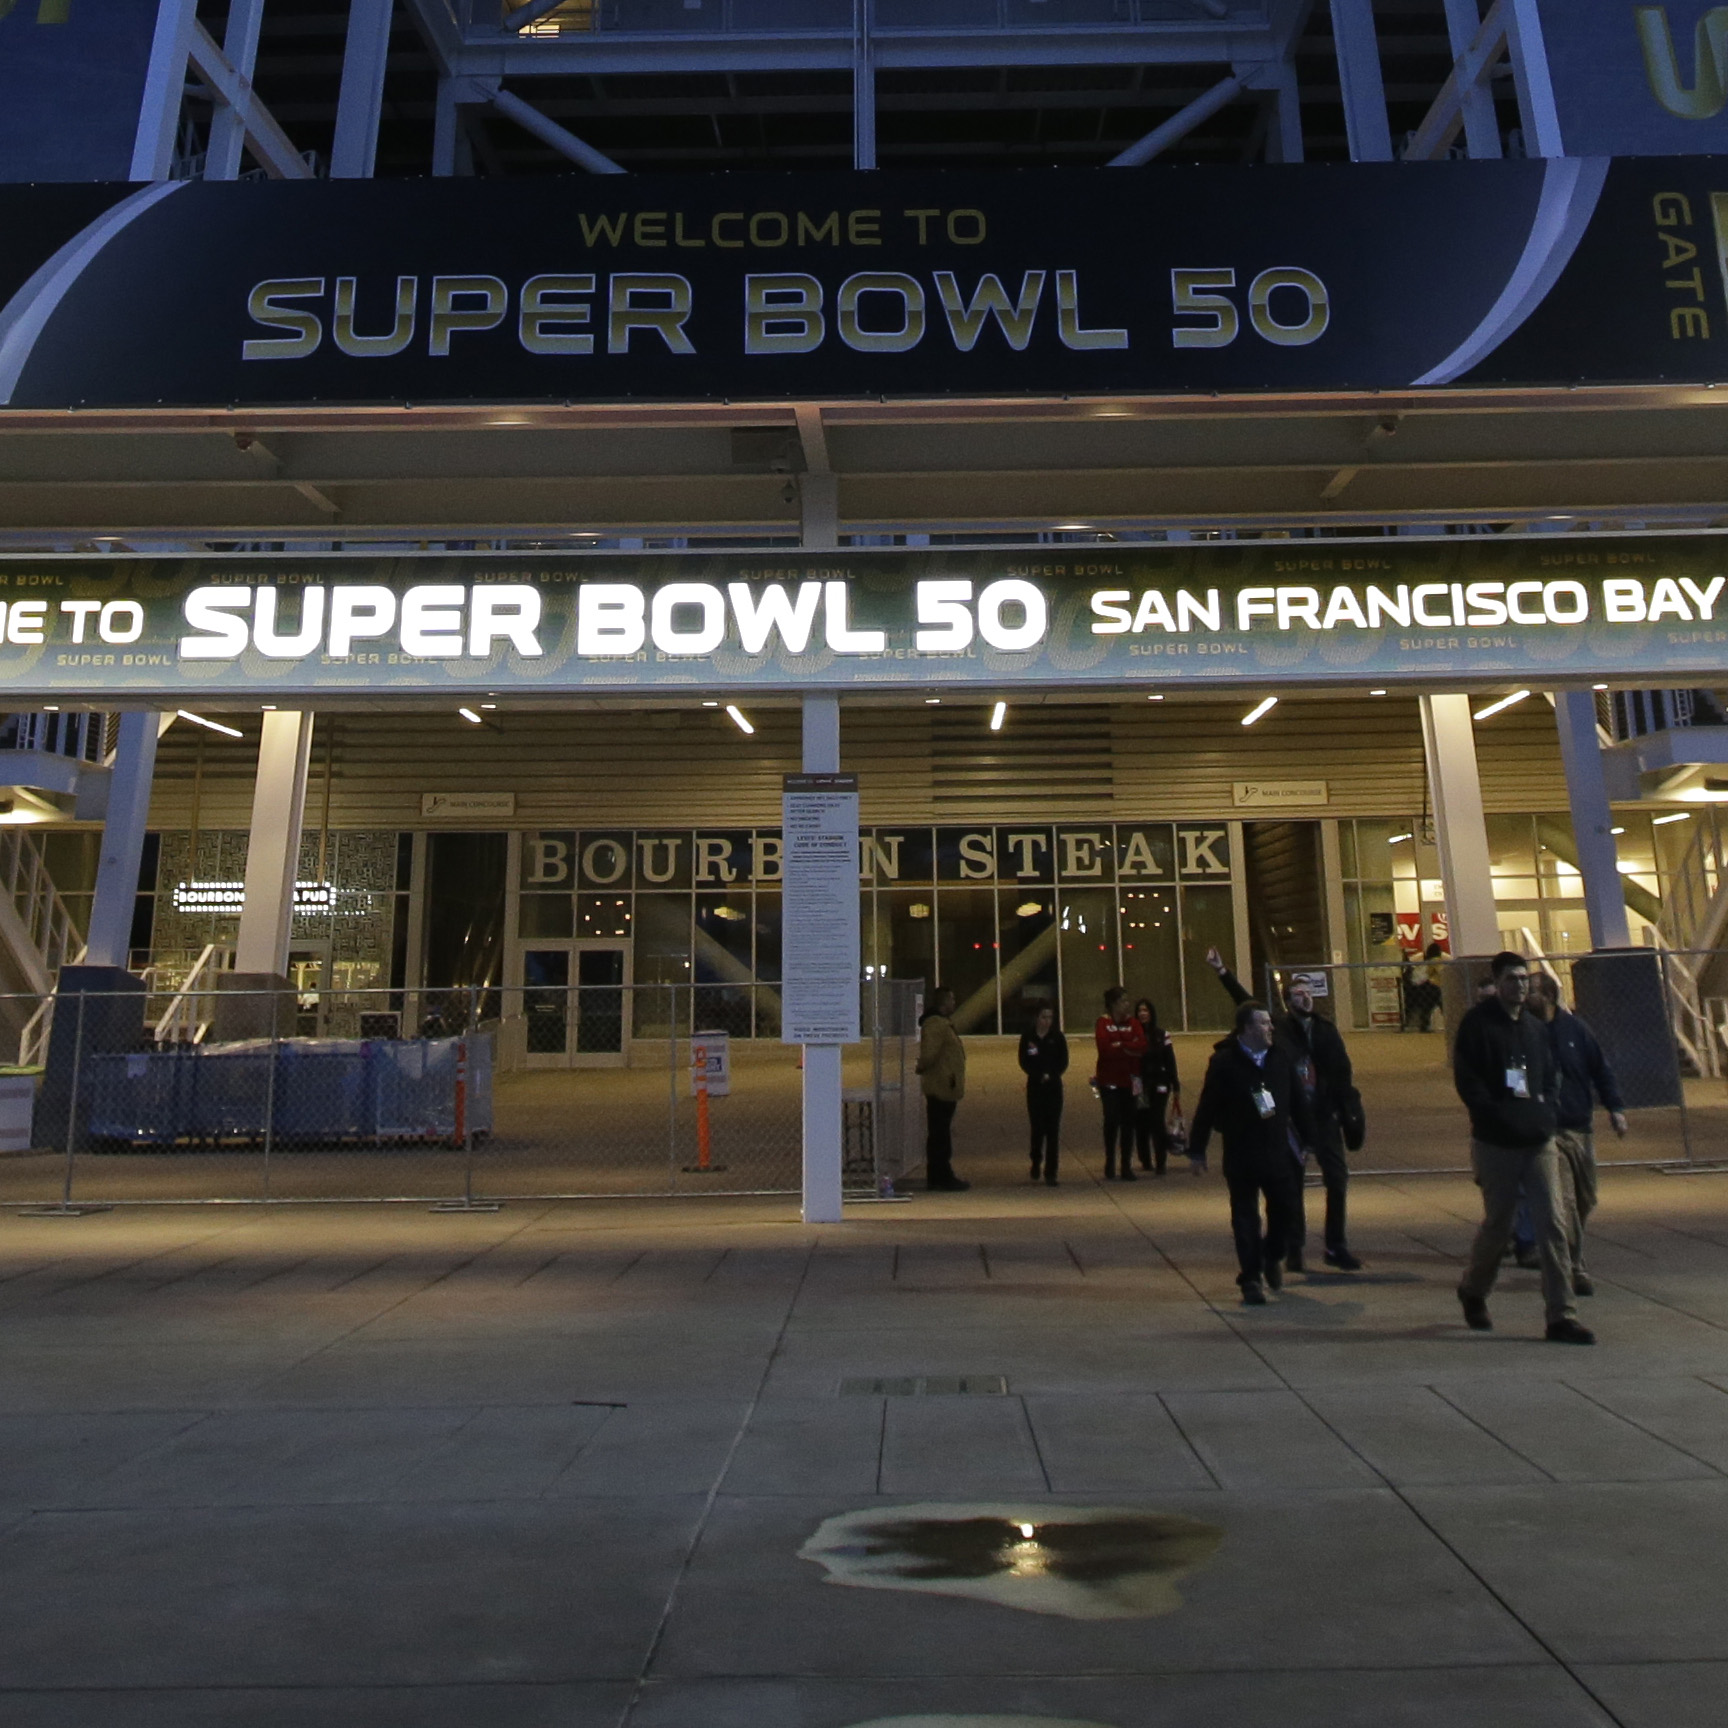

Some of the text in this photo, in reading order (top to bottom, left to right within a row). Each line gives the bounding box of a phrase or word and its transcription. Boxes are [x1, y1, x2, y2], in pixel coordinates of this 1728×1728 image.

[577, 208, 987, 249] WELCOME TO
[1652, 191, 1710, 341] GATE
[241, 266, 1331, 361] SUPER BOWL 50
[16, 575, 64, 586] BOWL
[60, 599, 145, 645] TO
[178, 585, 544, 660] SUPER
[576, 580, 886, 656] BOWL
[915, 578, 1048, 653] 50
[1090, 587, 1222, 636] SAN
[1236, 579, 1590, 631] FRANCISCO
[1602, 575, 1727, 623] BAY
[57, 654, 172, 667] SUPER BOWL
[527, 830, 1230, 884] BOURBN STEAK
[178, 890, 246, 903] BOURBON
[302, 890, 328, 902] PUB
